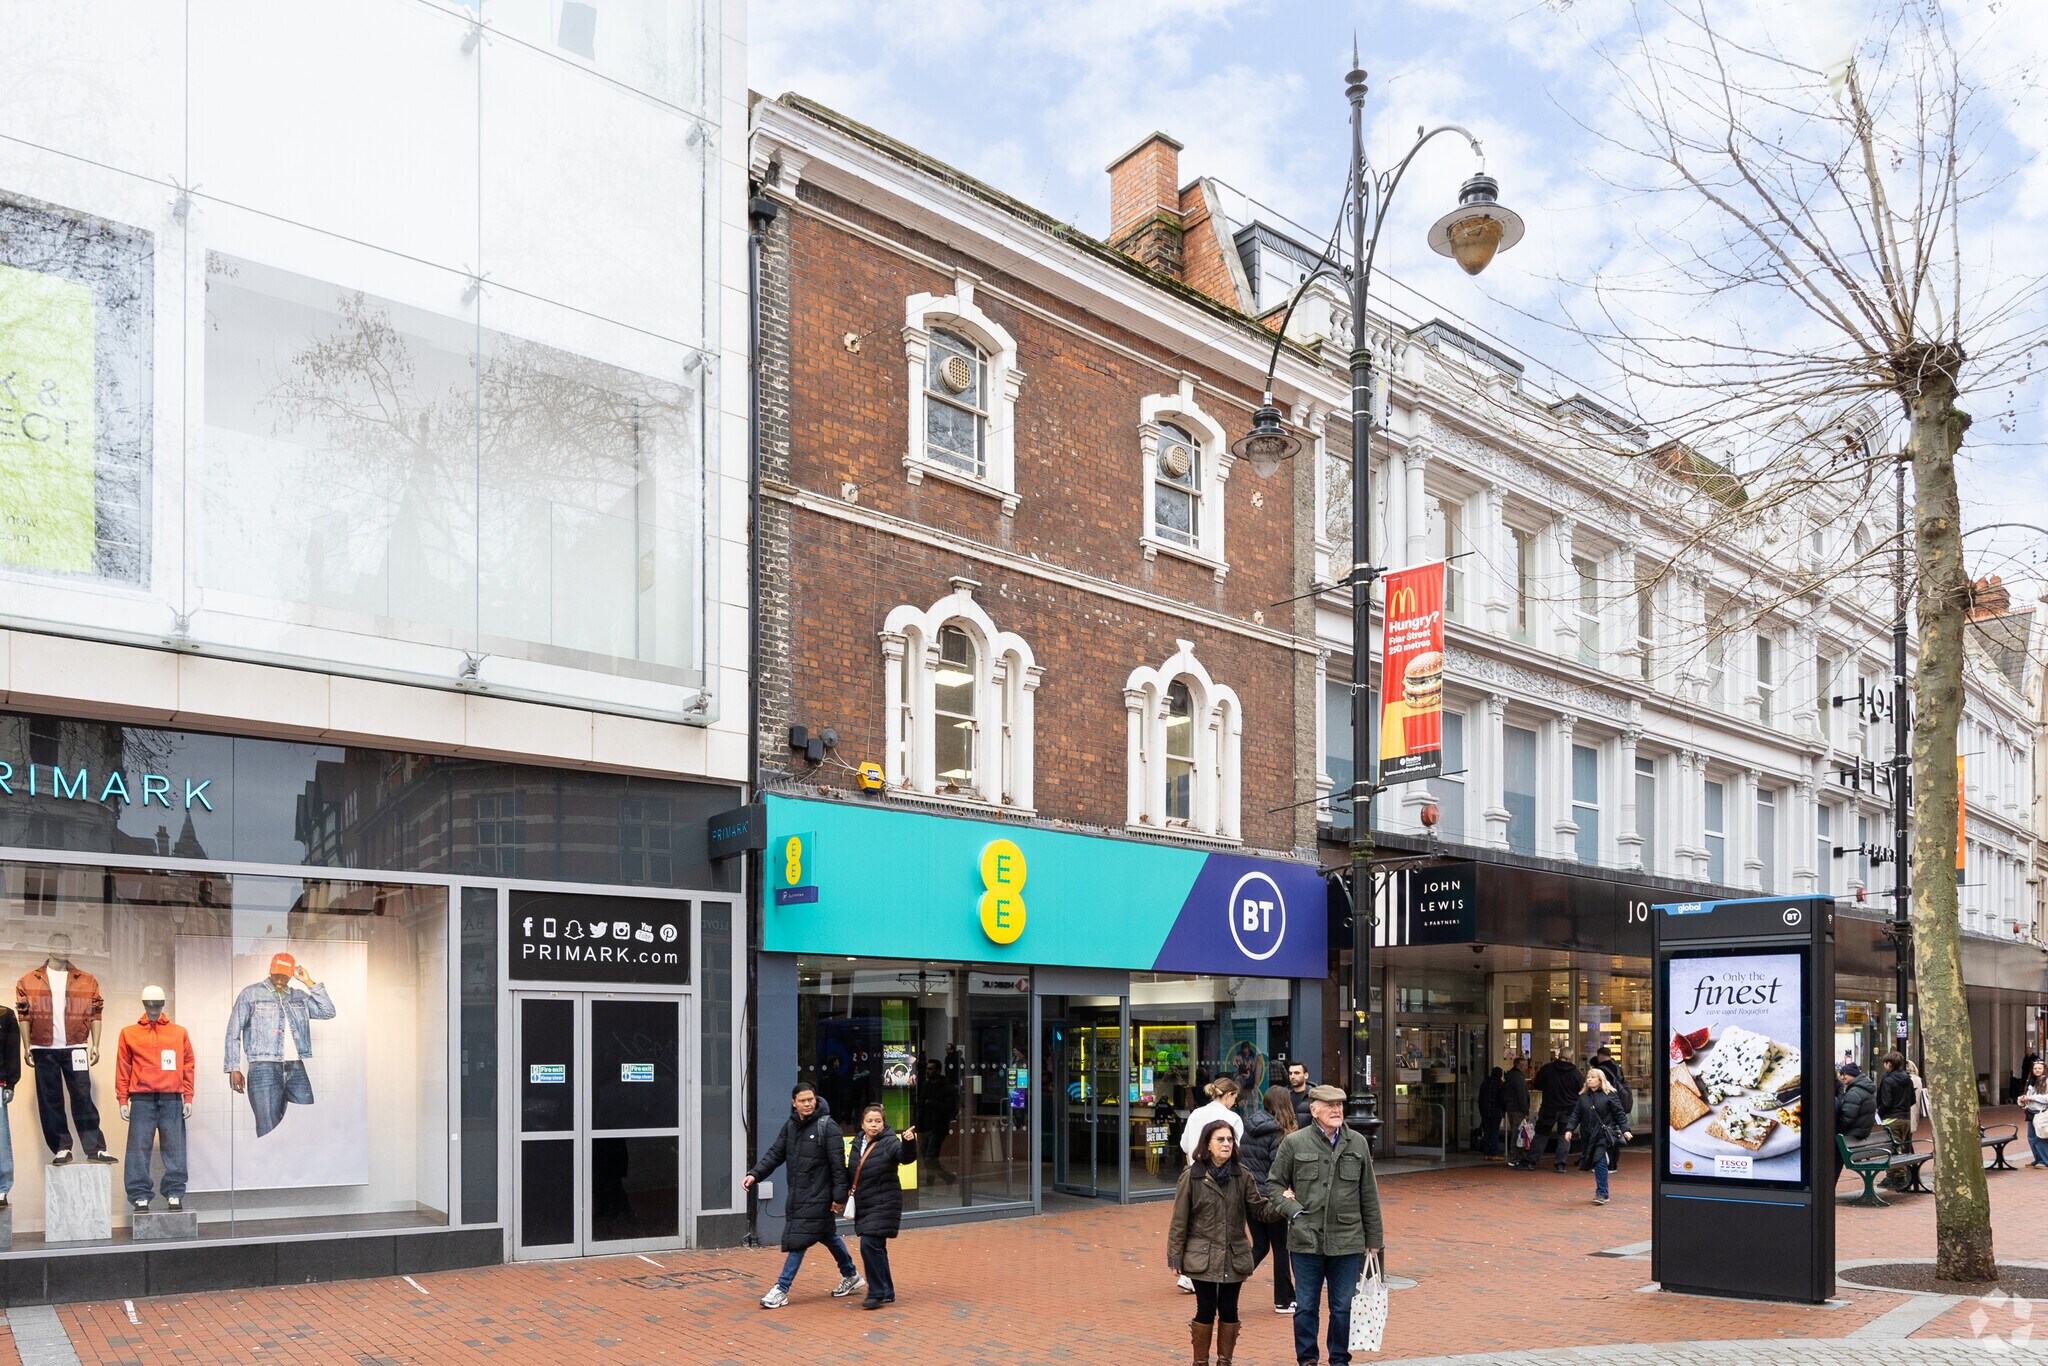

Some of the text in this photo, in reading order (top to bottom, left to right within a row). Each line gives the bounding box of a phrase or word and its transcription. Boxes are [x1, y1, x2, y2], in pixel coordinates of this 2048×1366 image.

[1388, 610, 1440, 634] Hungry?
[1388, 628, 1431, 646] Friar Street
[1388, 639, 1431, 656] 250 metres
[712, 820, 749, 842] PRIMARK
[1423, 880, 1461, 894] JOHN
[1420, 899, 1464, 912] LEWIS
[1677, 902, 1702, 914] global
[1243, 898, 1274, 932] BT
[1786, 912, 1798, 921] BT
[523, 944, 678, 964] PRIMARK.com
[1722, 971, 1766, 983] Only the
[1685, 975, 1783, 1015] finest
[1738, 1008, 1769, 1016] Roquefort
